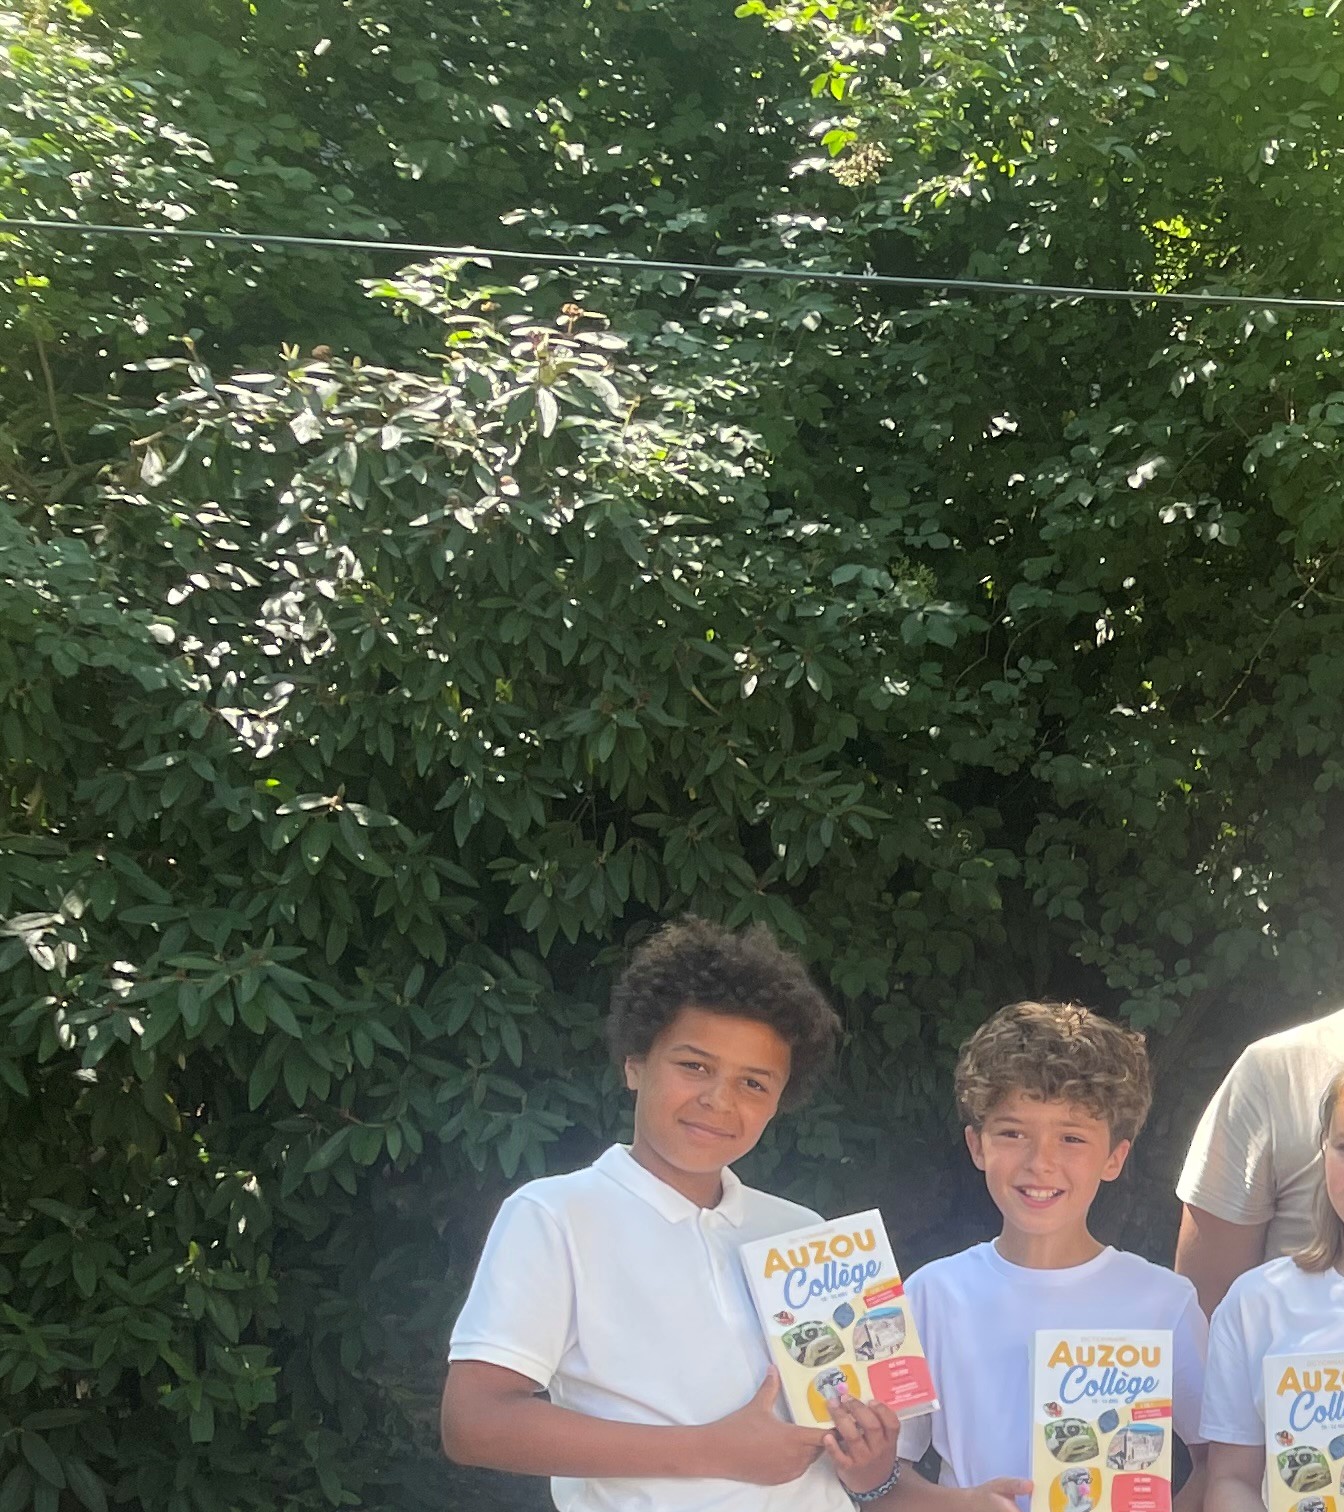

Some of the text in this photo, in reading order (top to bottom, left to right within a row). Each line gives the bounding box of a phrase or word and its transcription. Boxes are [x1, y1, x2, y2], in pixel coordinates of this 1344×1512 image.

[764, 1228, 876, 1279] AUZOU
[783, 1259, 882, 1310] Collège
[1047, 1340, 1161, 1369] AUZOU
[1059, 1365, 1160, 1404] Collège
